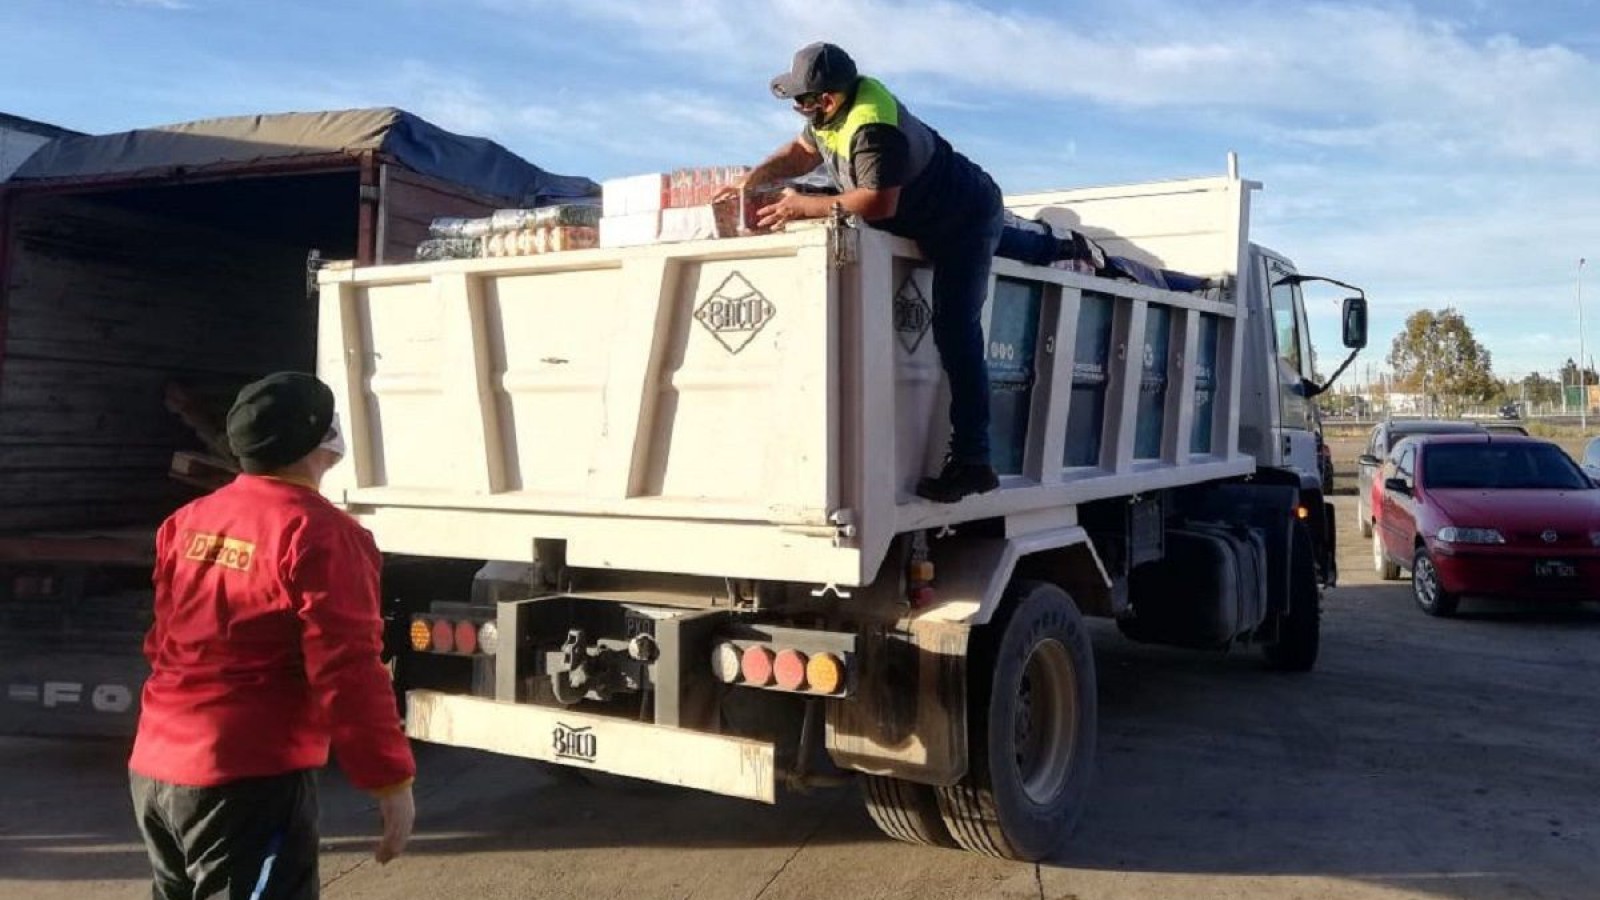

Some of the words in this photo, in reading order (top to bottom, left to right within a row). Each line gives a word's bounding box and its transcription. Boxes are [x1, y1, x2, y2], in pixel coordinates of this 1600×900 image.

[708, 299, 763, 330] BACO
[192, 538, 250, 569] Drco
[552, 727, 597, 758] BACO
